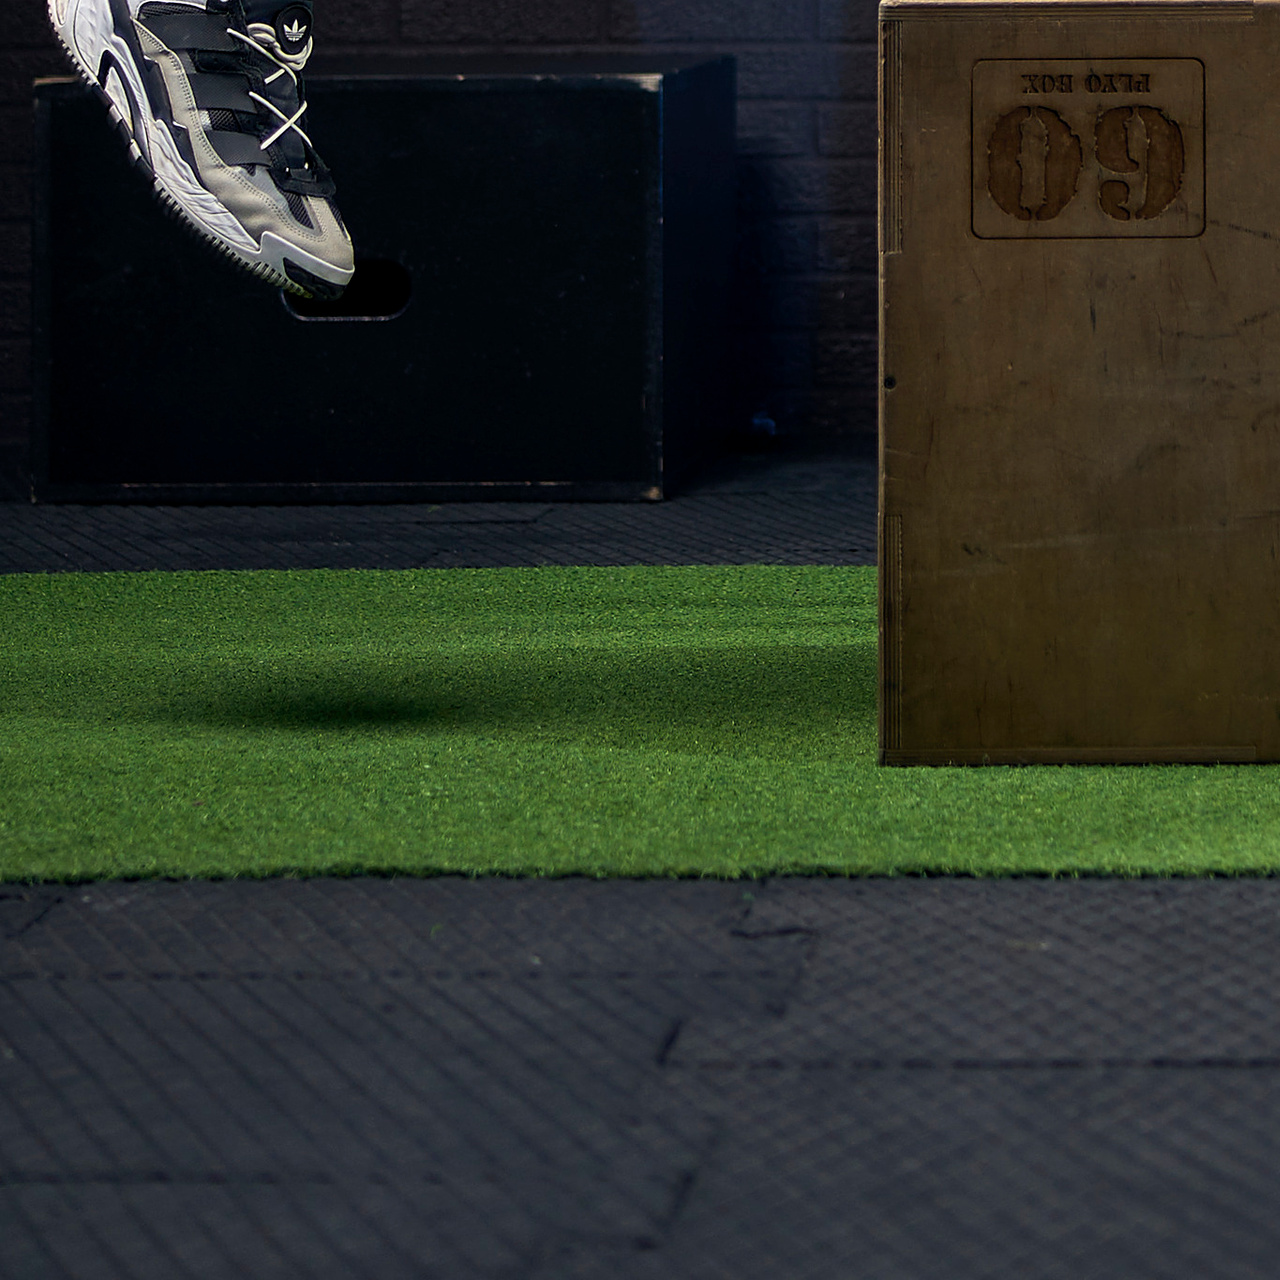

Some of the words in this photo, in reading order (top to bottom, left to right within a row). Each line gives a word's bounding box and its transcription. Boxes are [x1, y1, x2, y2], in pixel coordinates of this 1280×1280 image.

[1021, 73, 1074, 94] BOX
[1085, 73, 1151, 94] PLYO
[986, 105, 1185, 222] 60
